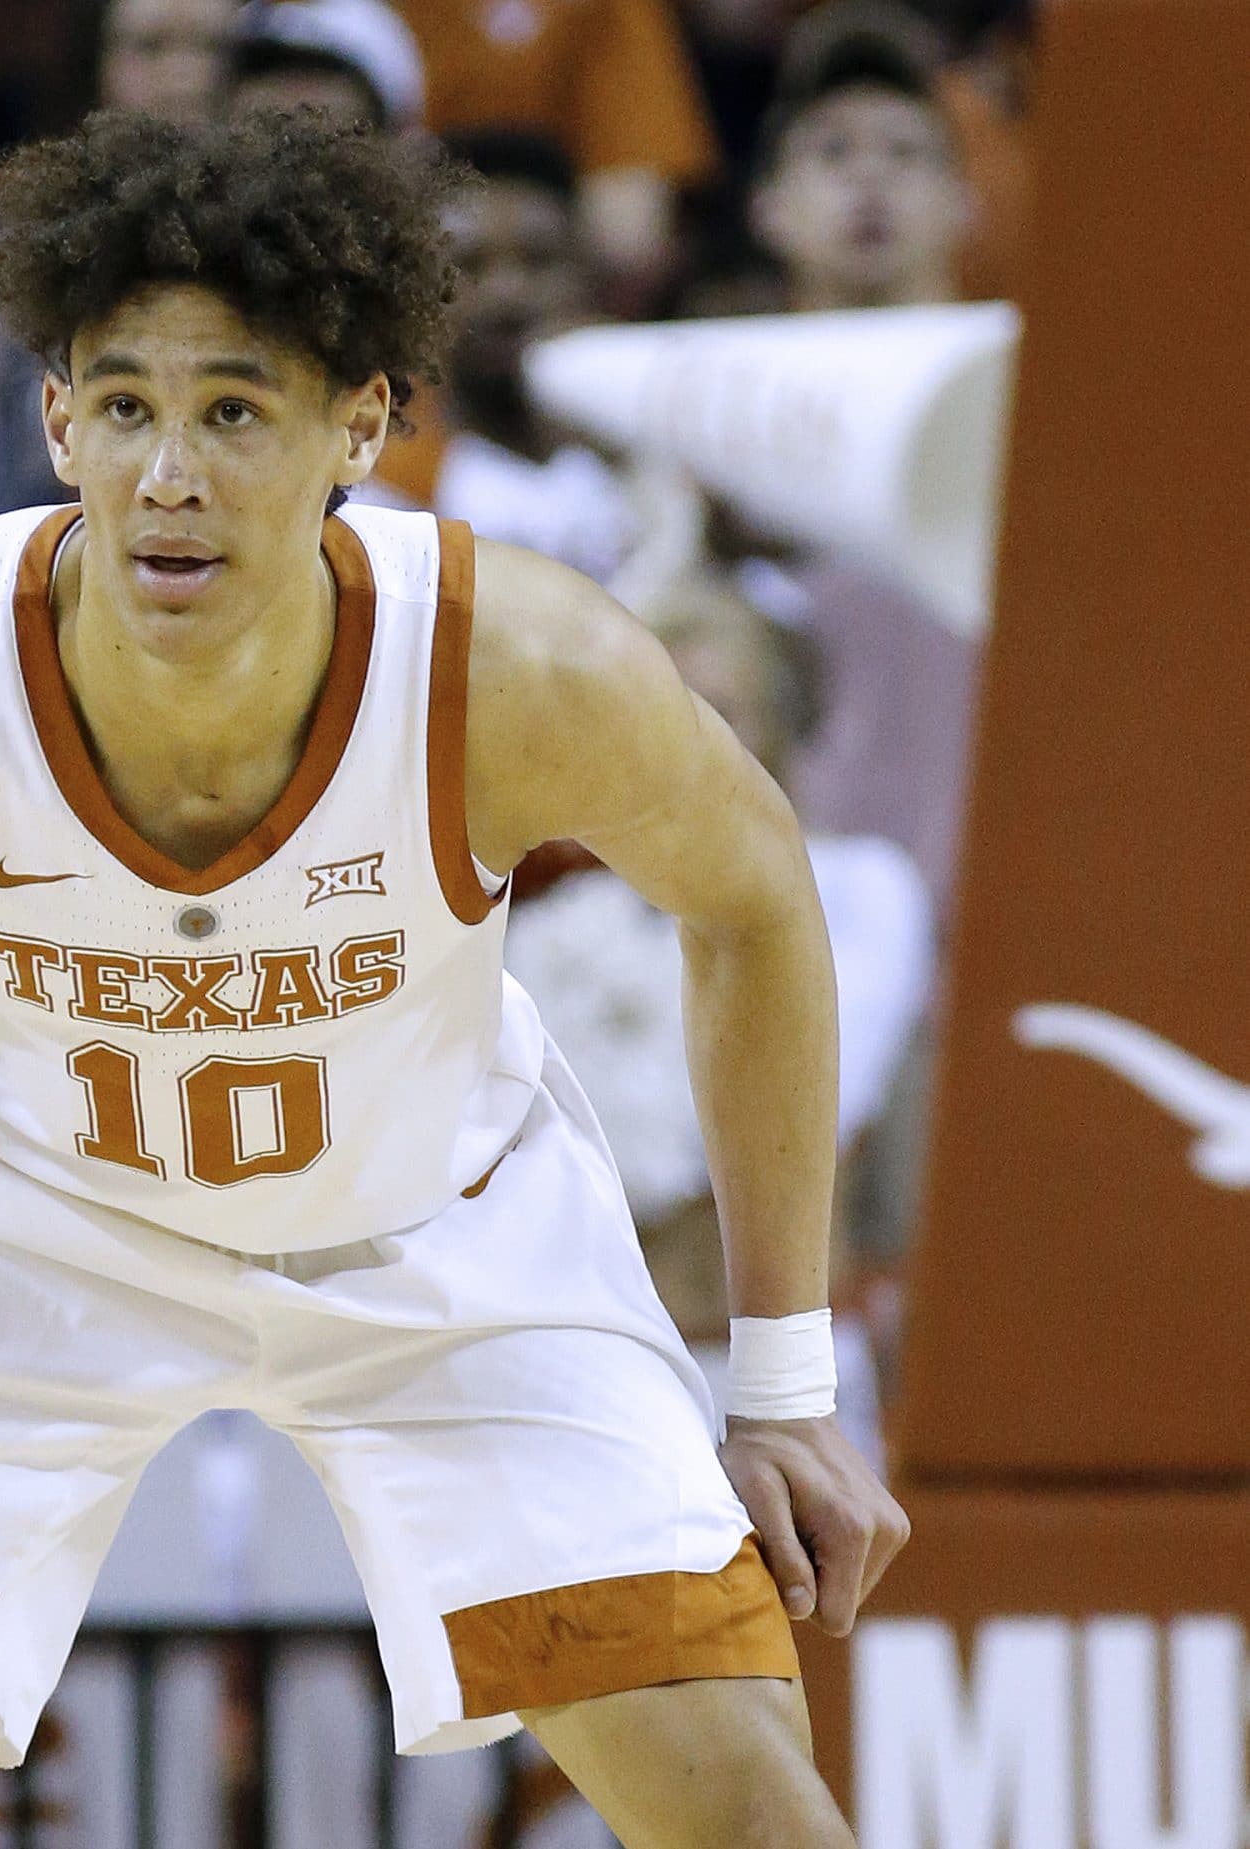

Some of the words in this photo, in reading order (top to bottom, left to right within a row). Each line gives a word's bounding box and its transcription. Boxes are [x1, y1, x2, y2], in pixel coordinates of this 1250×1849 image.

[303, 851, 387, 910] XII
[66, 1040, 331, 1190] 10
[852, 1612, 1250, 1849] MU
